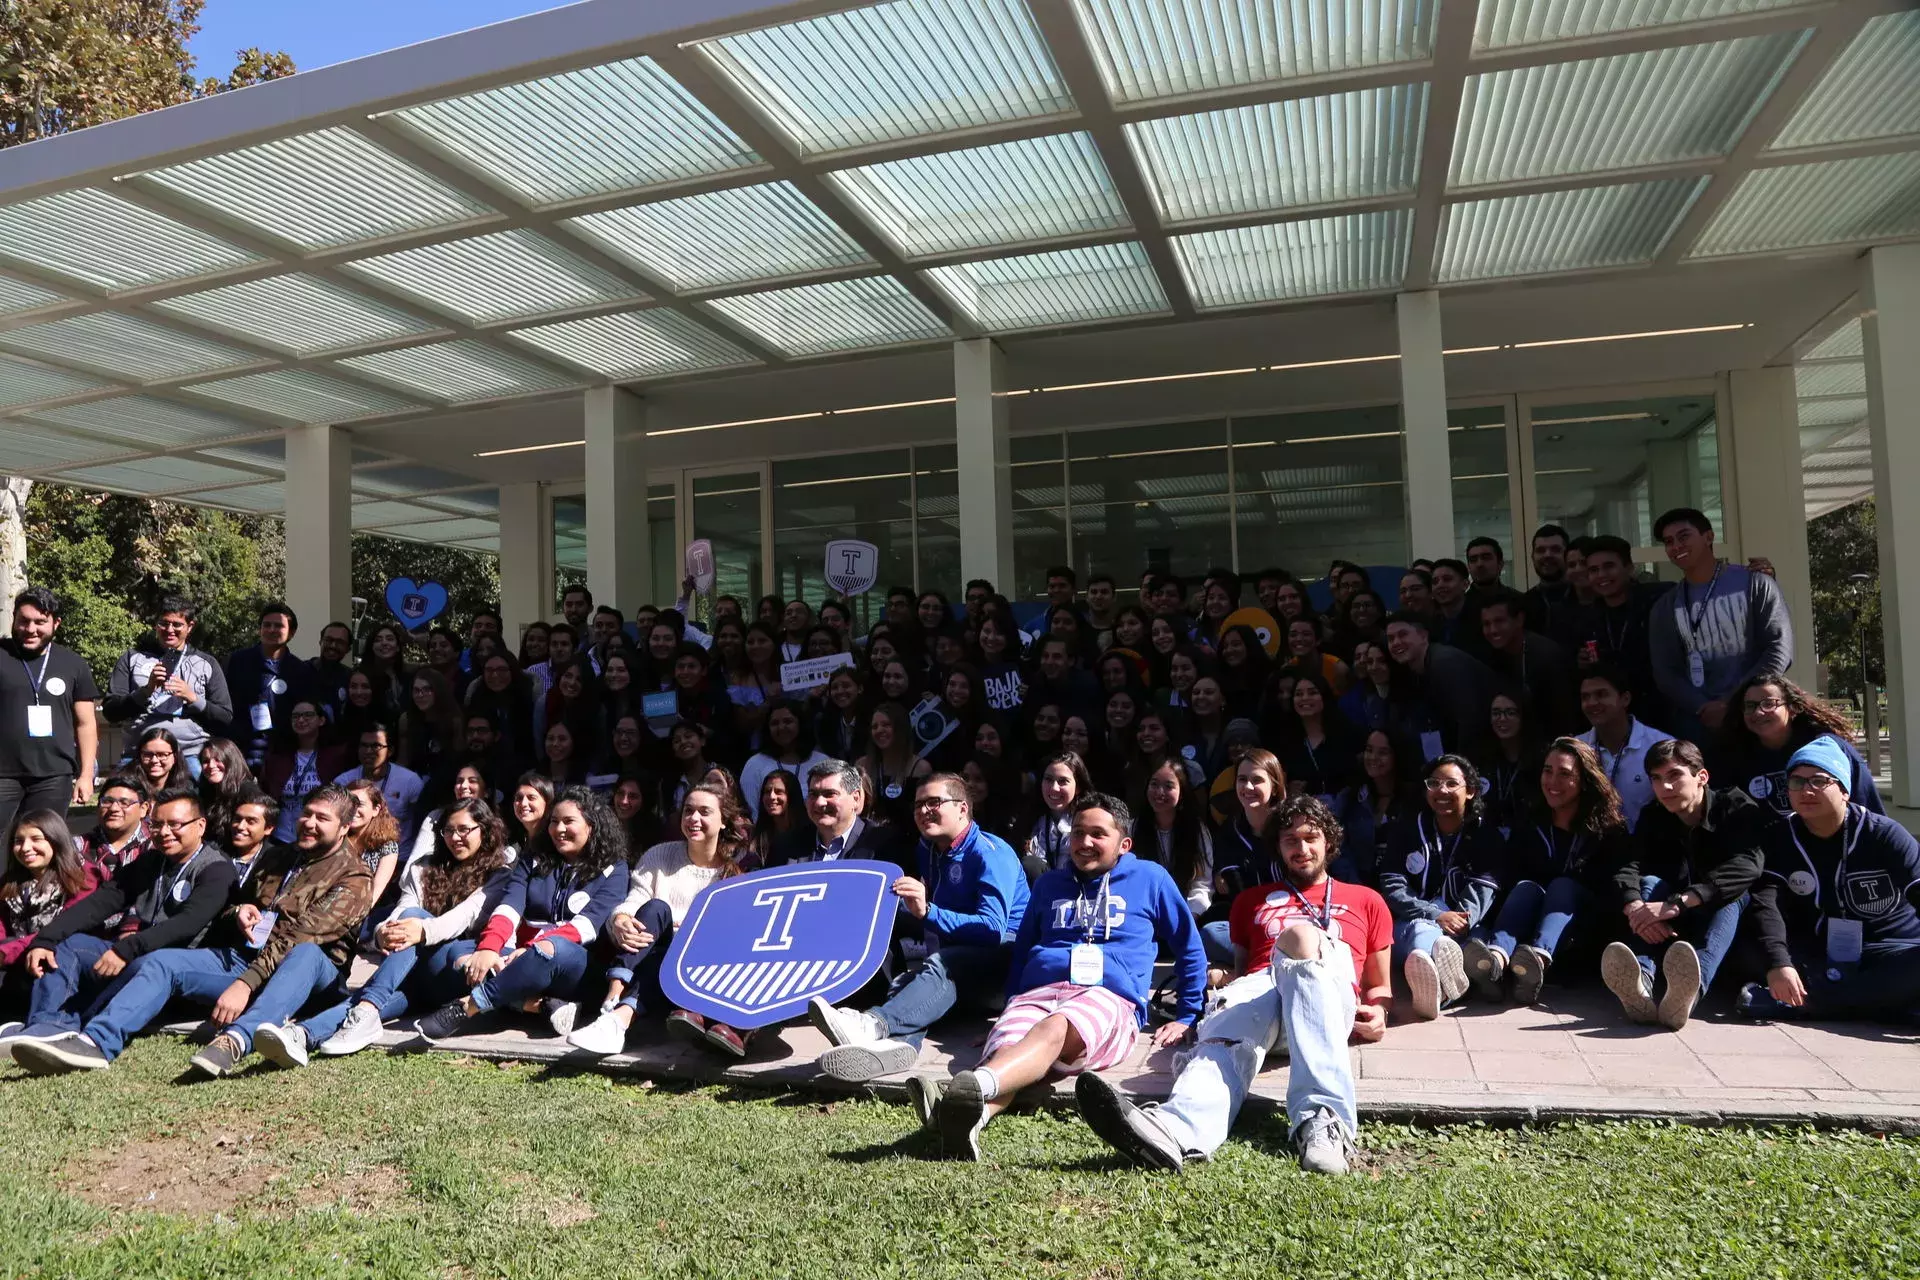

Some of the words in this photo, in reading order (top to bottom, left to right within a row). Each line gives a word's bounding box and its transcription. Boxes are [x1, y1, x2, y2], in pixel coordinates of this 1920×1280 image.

[693, 550, 704, 575] T
[842, 550, 861, 575] T
[410, 597, 421, 611] T
[984, 670, 1021, 699] BAJA
[1860, 880, 1879, 900] T
[752, 883, 828, 952] T
